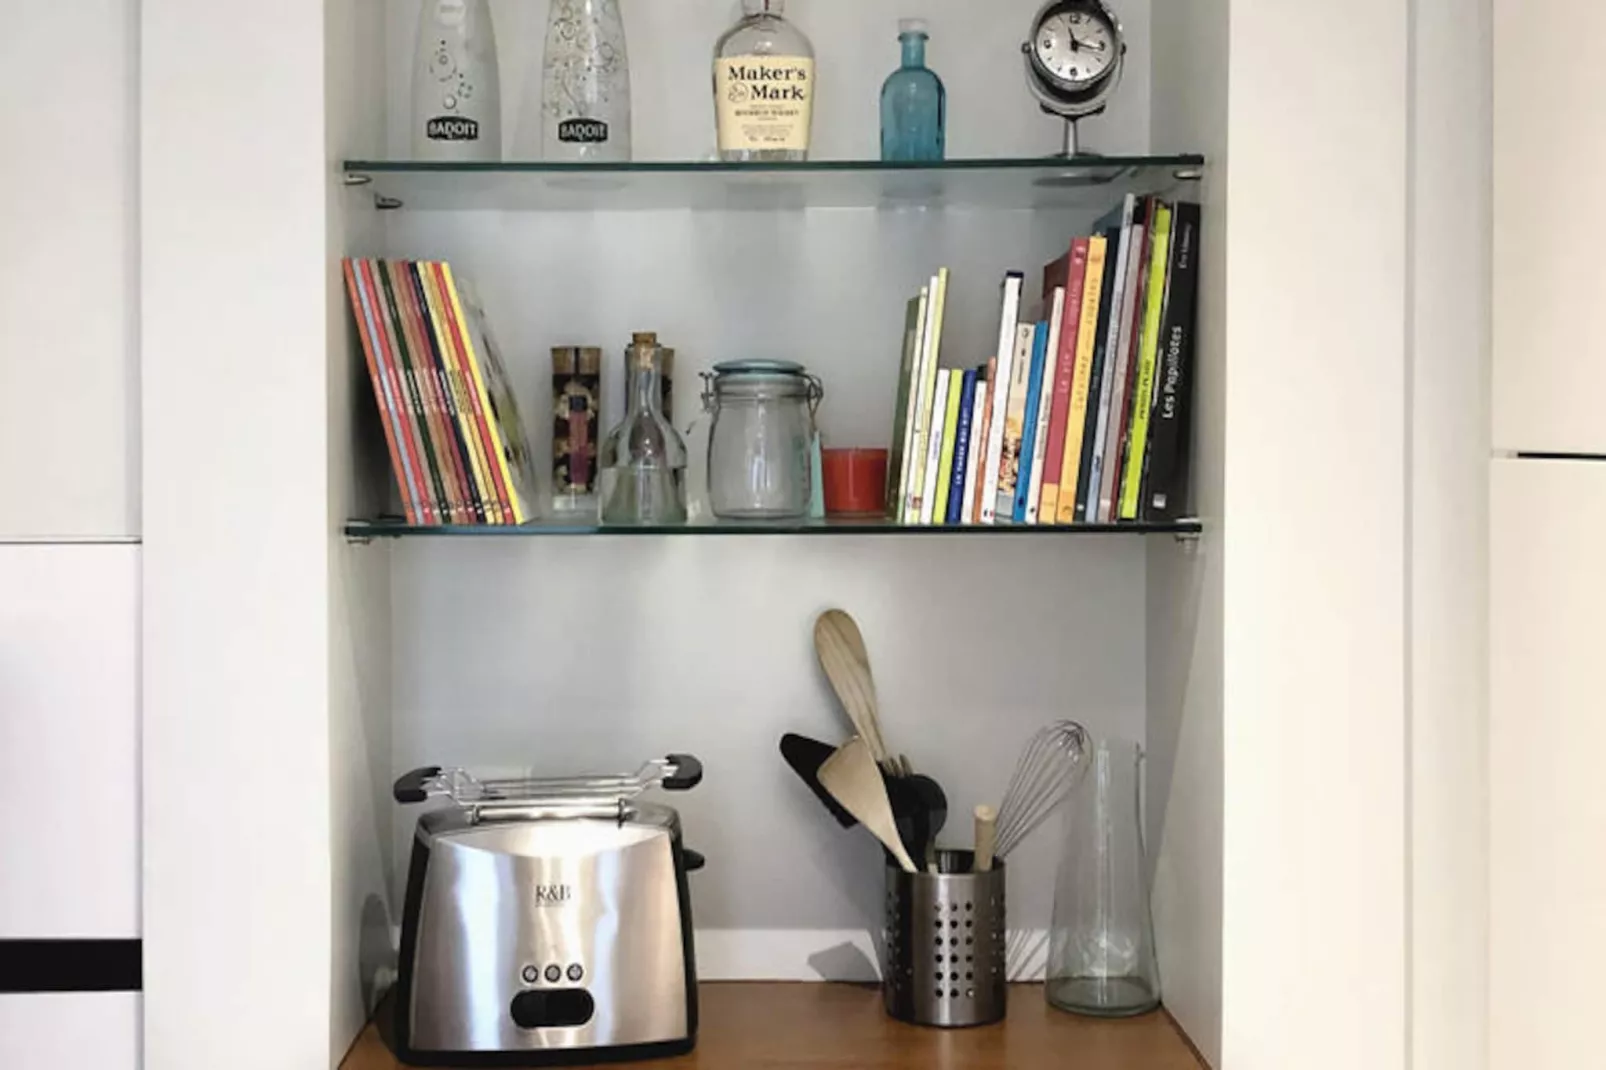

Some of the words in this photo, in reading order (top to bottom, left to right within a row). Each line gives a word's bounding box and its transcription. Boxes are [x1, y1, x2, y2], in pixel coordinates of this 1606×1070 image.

[728, 65, 806, 80] Maker's
[751, 84, 804, 100] Mark
[1163, 325, 1182, 393] Papillotes
[1162, 395, 1176, 418] Les
[535, 884, 571, 902] R&B
